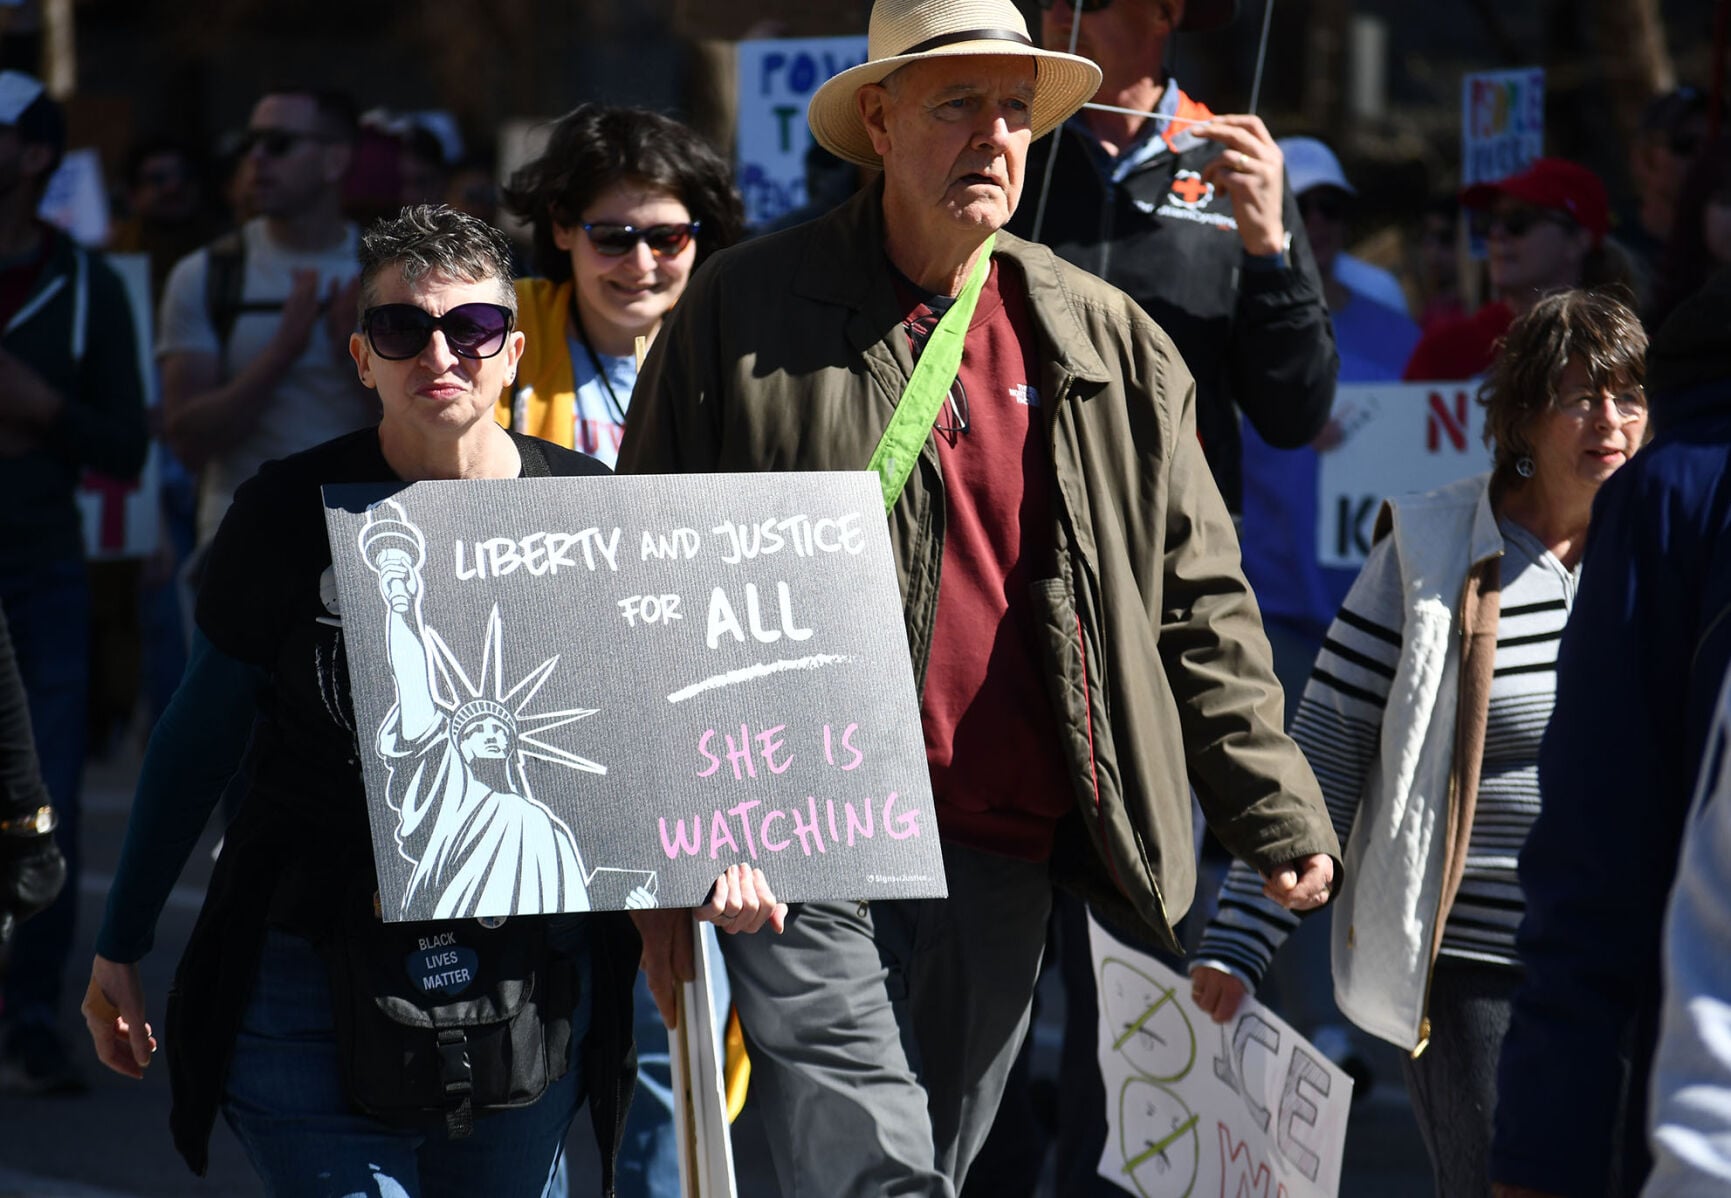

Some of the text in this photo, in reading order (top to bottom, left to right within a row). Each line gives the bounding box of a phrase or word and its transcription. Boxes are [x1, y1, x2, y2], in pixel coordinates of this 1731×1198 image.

[455, 513, 866, 580] LIBERTY AND JUSTICE
[617, 581, 813, 649] FOR ALL
[696, 723, 863, 780] SHE IS
[658, 791, 920, 860] WATCHING
[418, 931, 457, 951] BLACK
[425, 951, 458, 969] LIVES
[422, 968, 470, 991] MATTER
